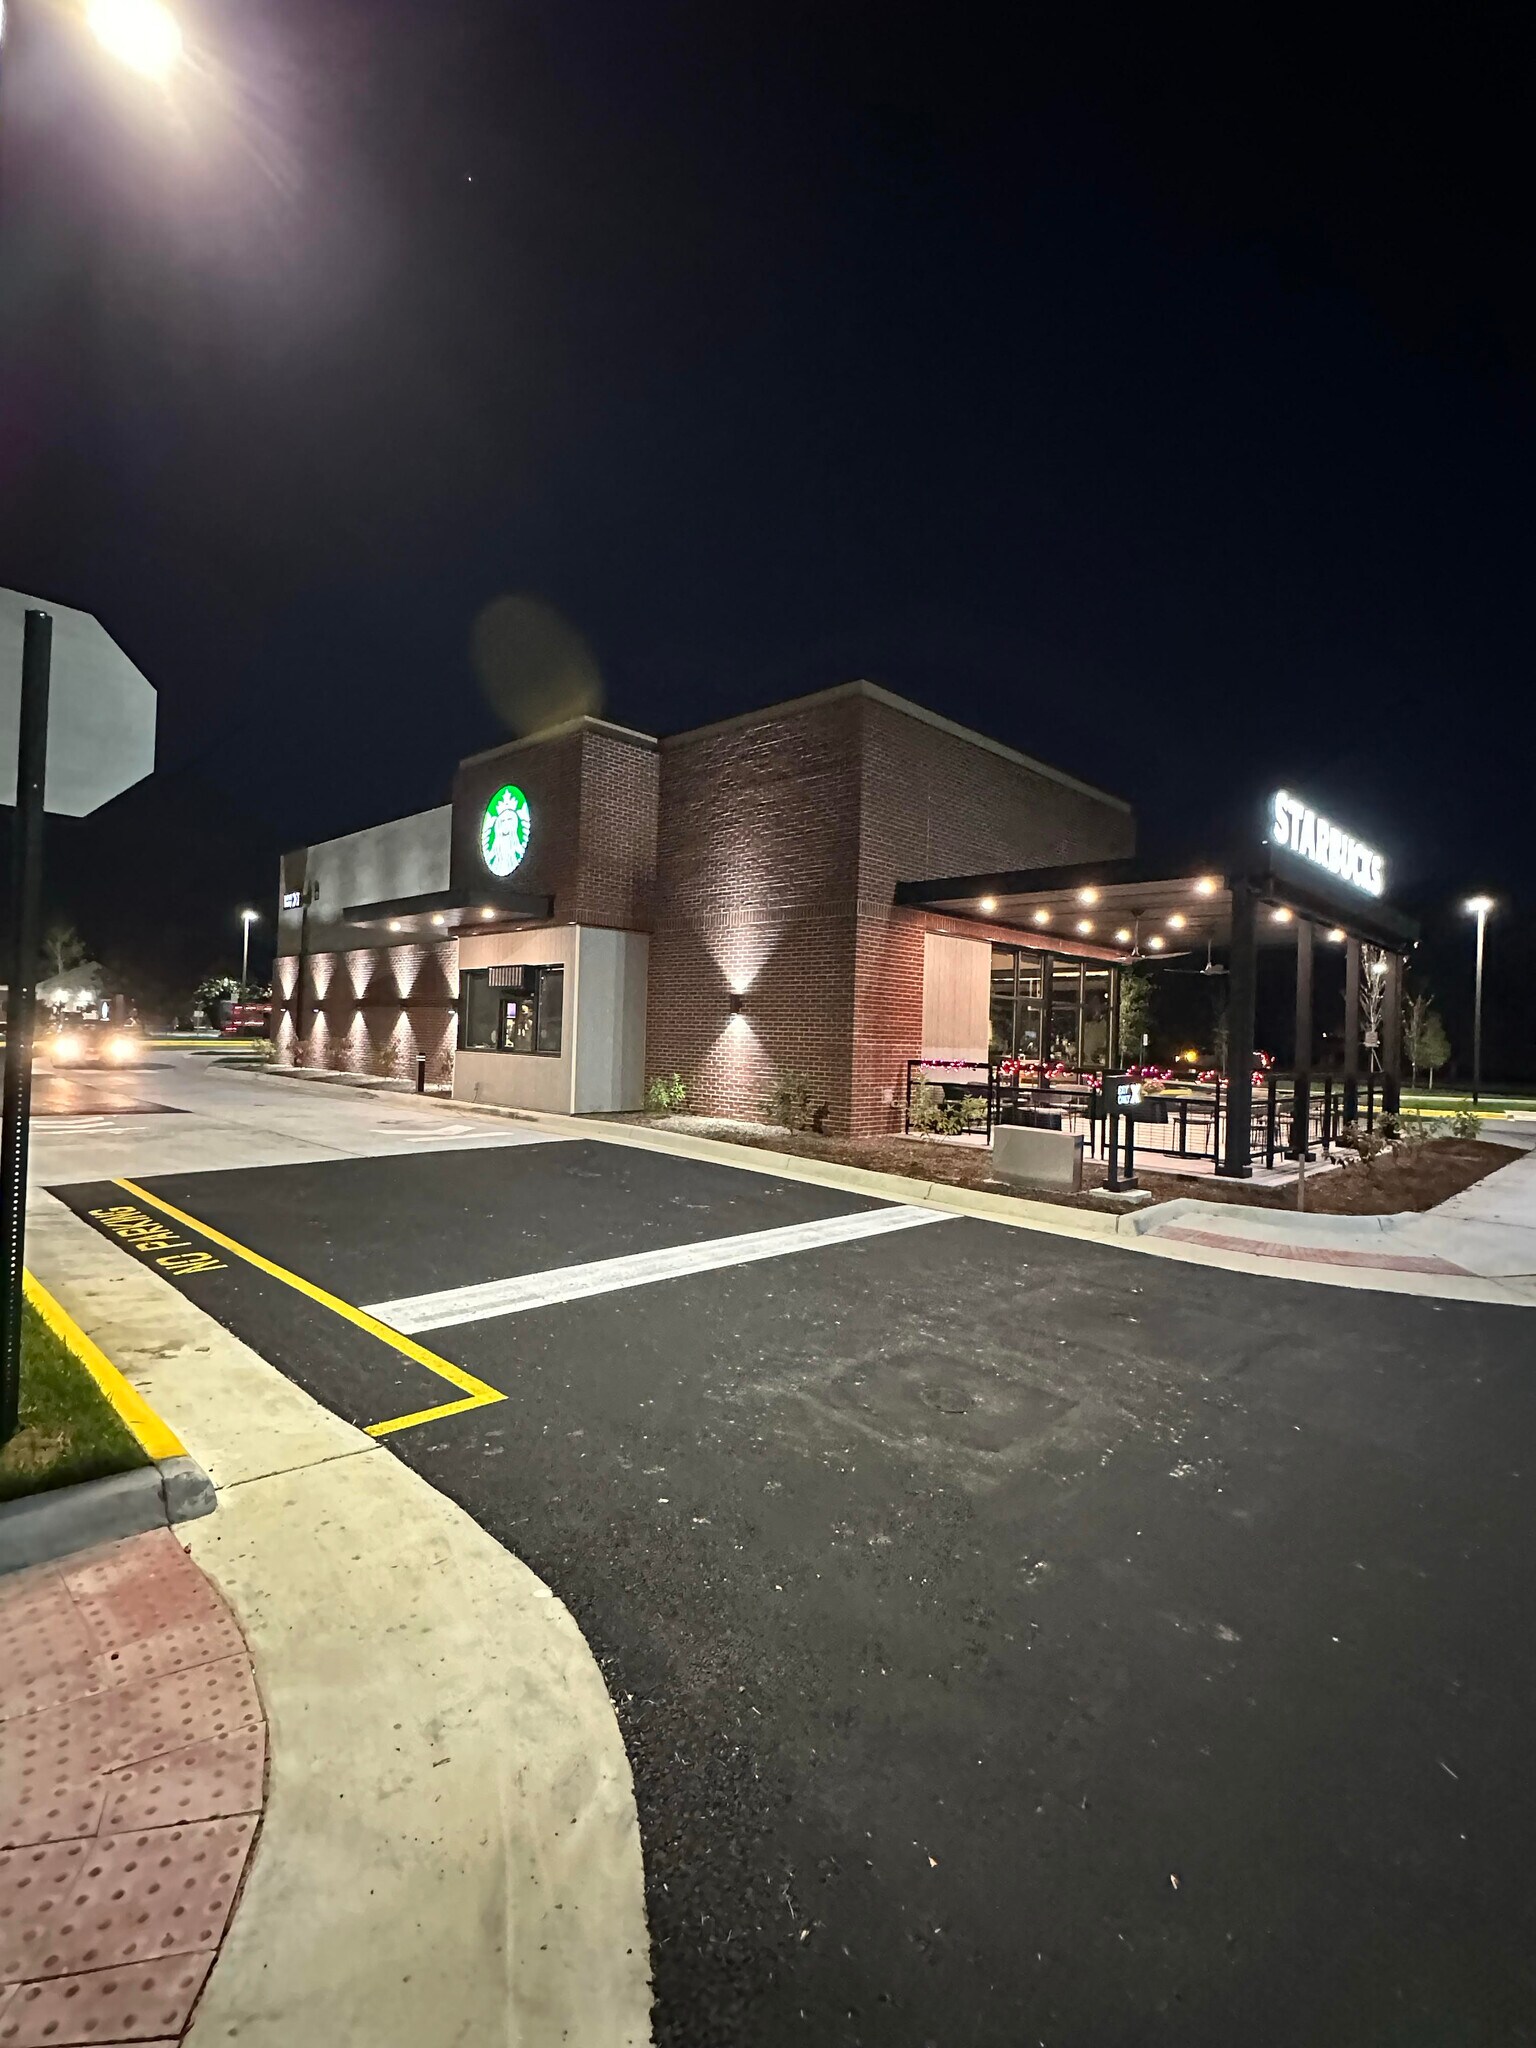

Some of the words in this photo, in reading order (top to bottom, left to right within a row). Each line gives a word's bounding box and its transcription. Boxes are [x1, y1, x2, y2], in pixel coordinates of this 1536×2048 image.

[1273, 788, 1384, 897] STARBUCKS
[88, 1206, 192, 1252] PARKING
[156, 1252, 228, 1275] NO
